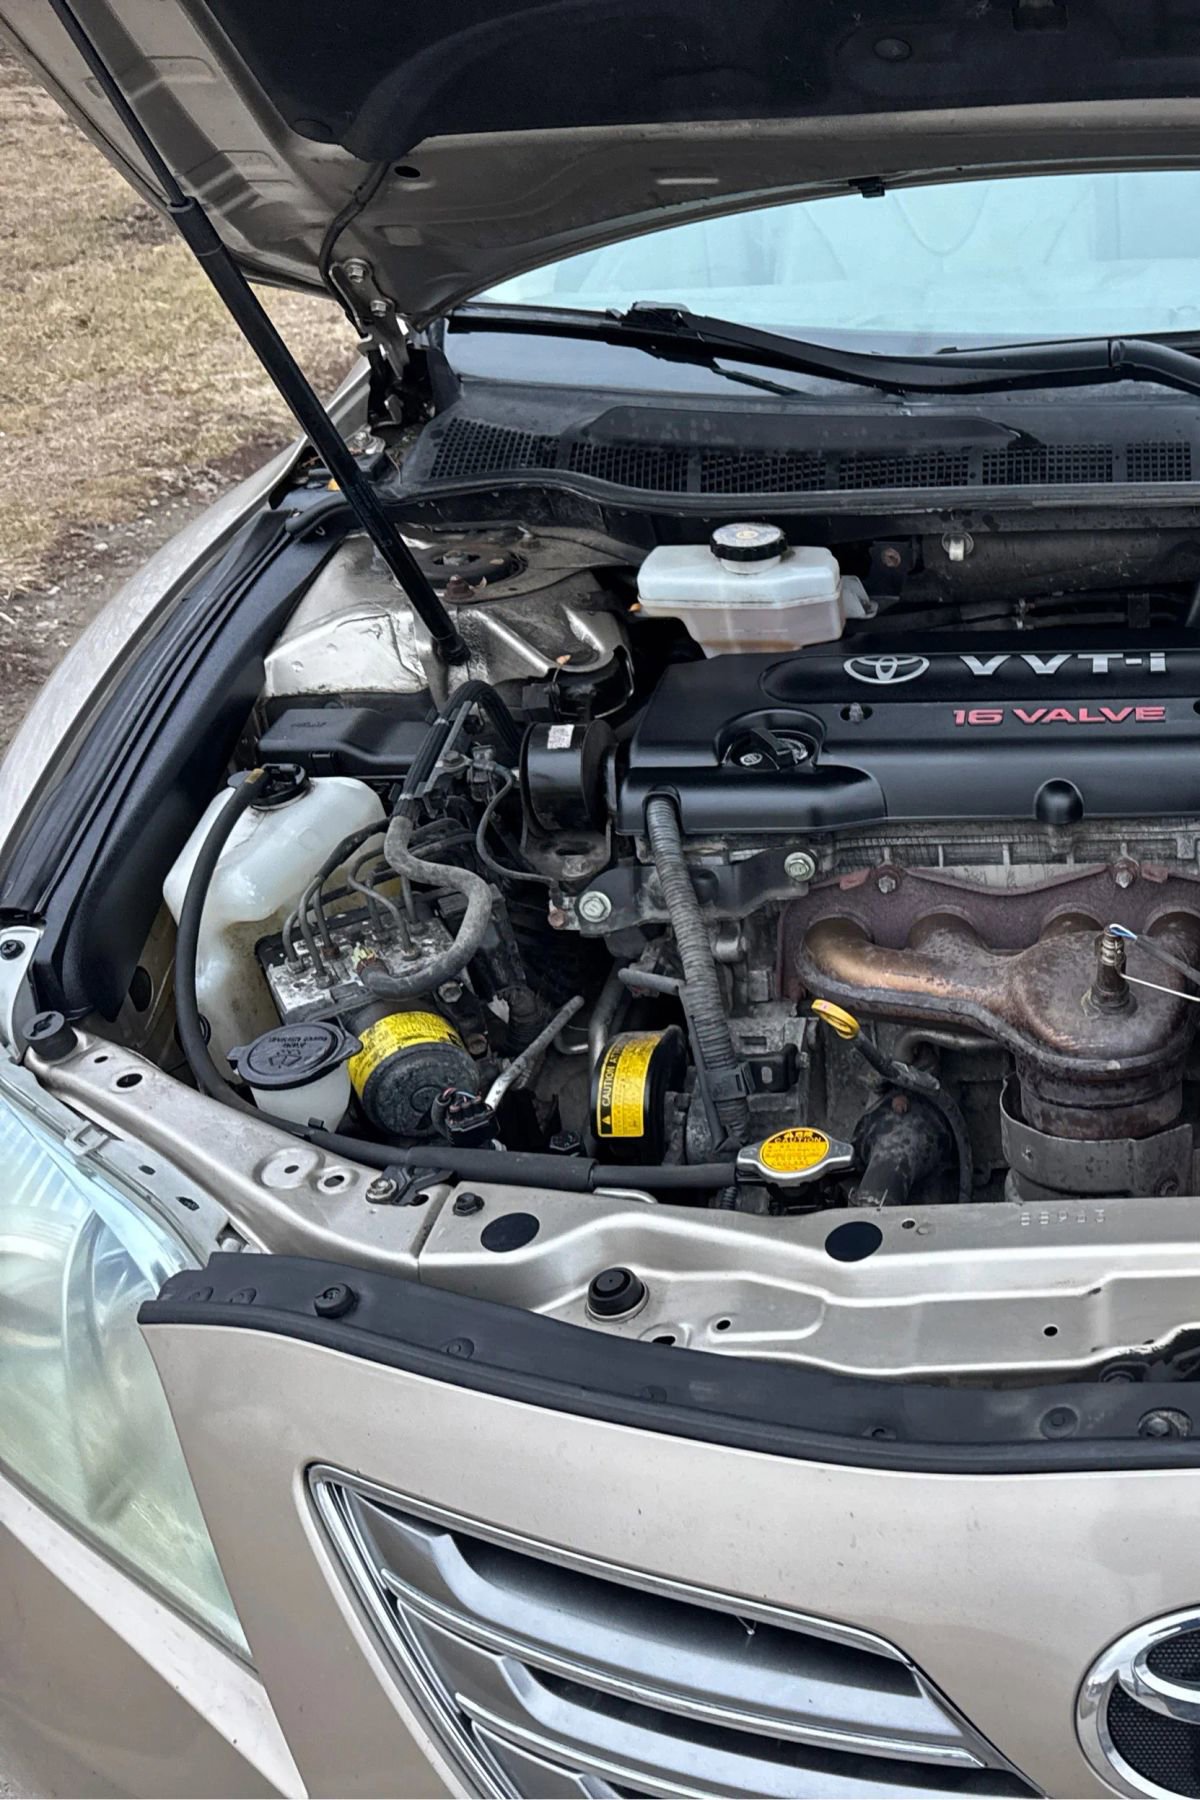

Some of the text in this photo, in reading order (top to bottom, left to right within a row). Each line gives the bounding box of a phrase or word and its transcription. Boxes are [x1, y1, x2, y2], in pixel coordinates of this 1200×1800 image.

[959, 652, 1167, 676] VVT-i
[953, 706, 1167, 726] 16 VALVE
[602, 1064, 616, 1107] CAUTION
[774, 1136, 822, 1144] CAUTION
